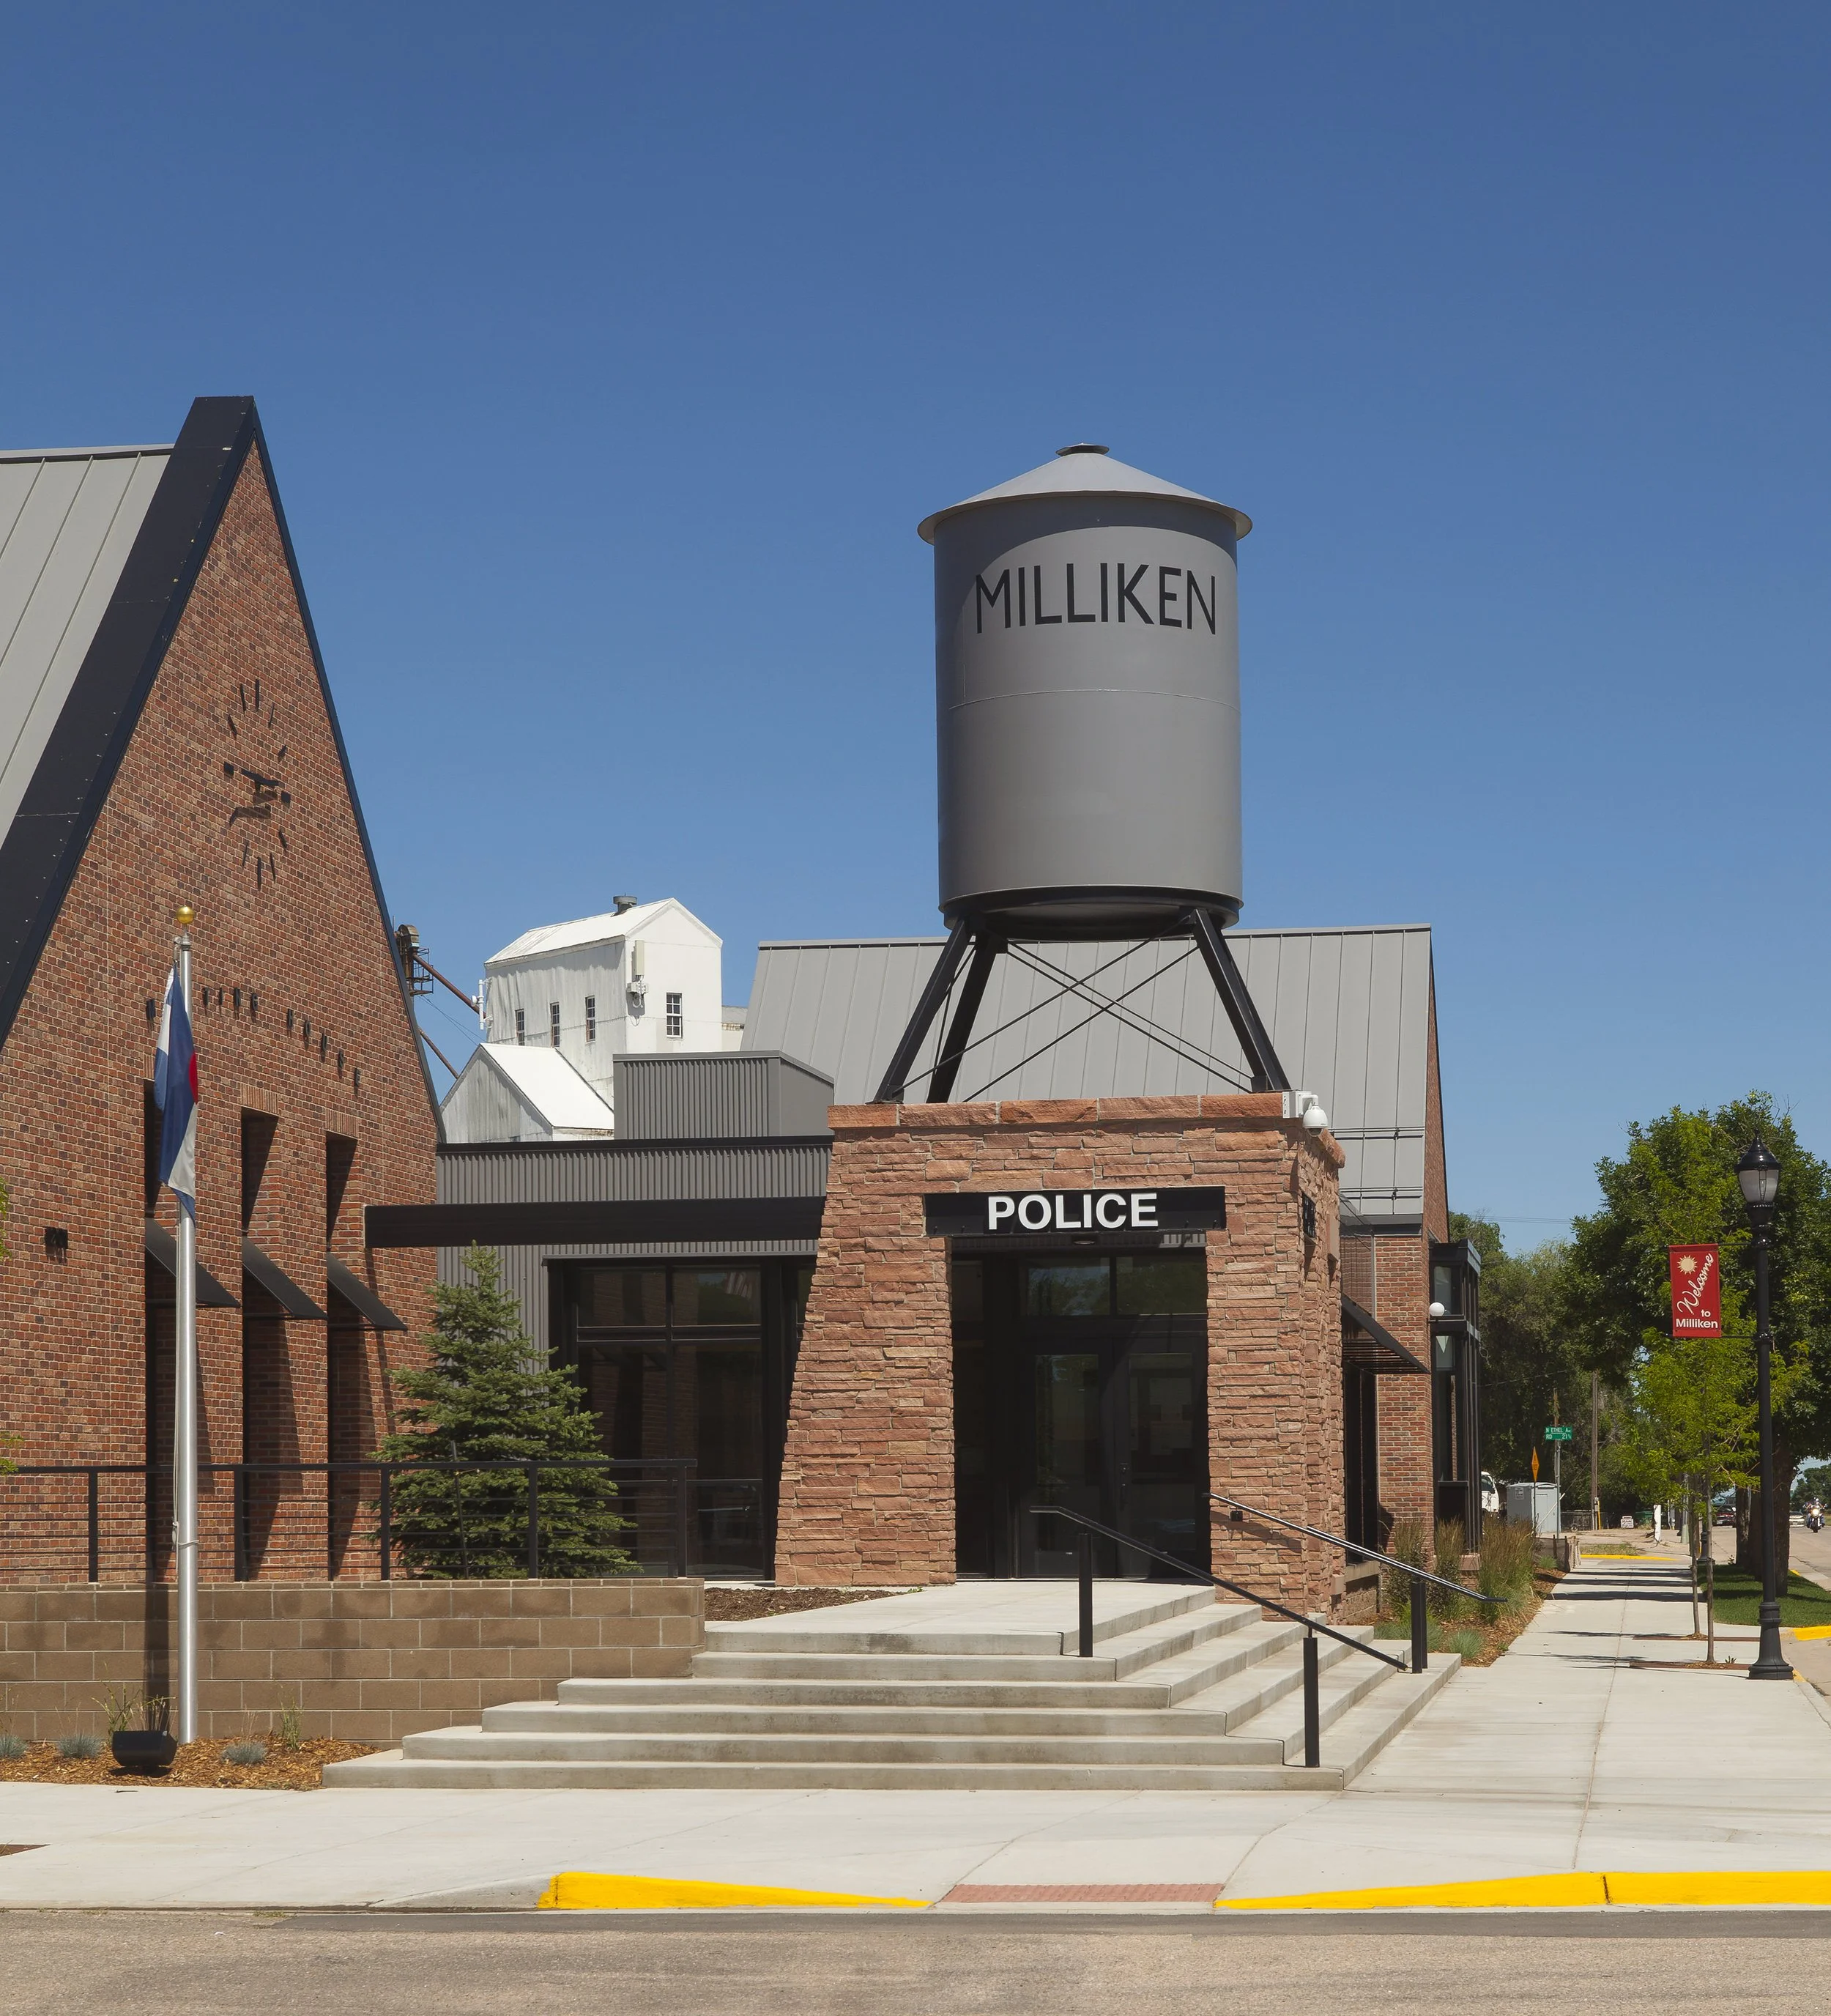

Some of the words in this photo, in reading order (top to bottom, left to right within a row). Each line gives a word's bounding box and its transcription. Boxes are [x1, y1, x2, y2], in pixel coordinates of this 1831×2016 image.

[976, 563, 1216, 635] MILLIKEN
[146, 987, 258, 1020] MTING
[287, 1008, 361, 1088] HOUSE
[987, 1193, 1158, 1230] POLICE
[1676, 1253, 1715, 1315] Welcome
[1676, 1319, 1718, 1328] Milliken
[1701, 1309, 1711, 1317] to
